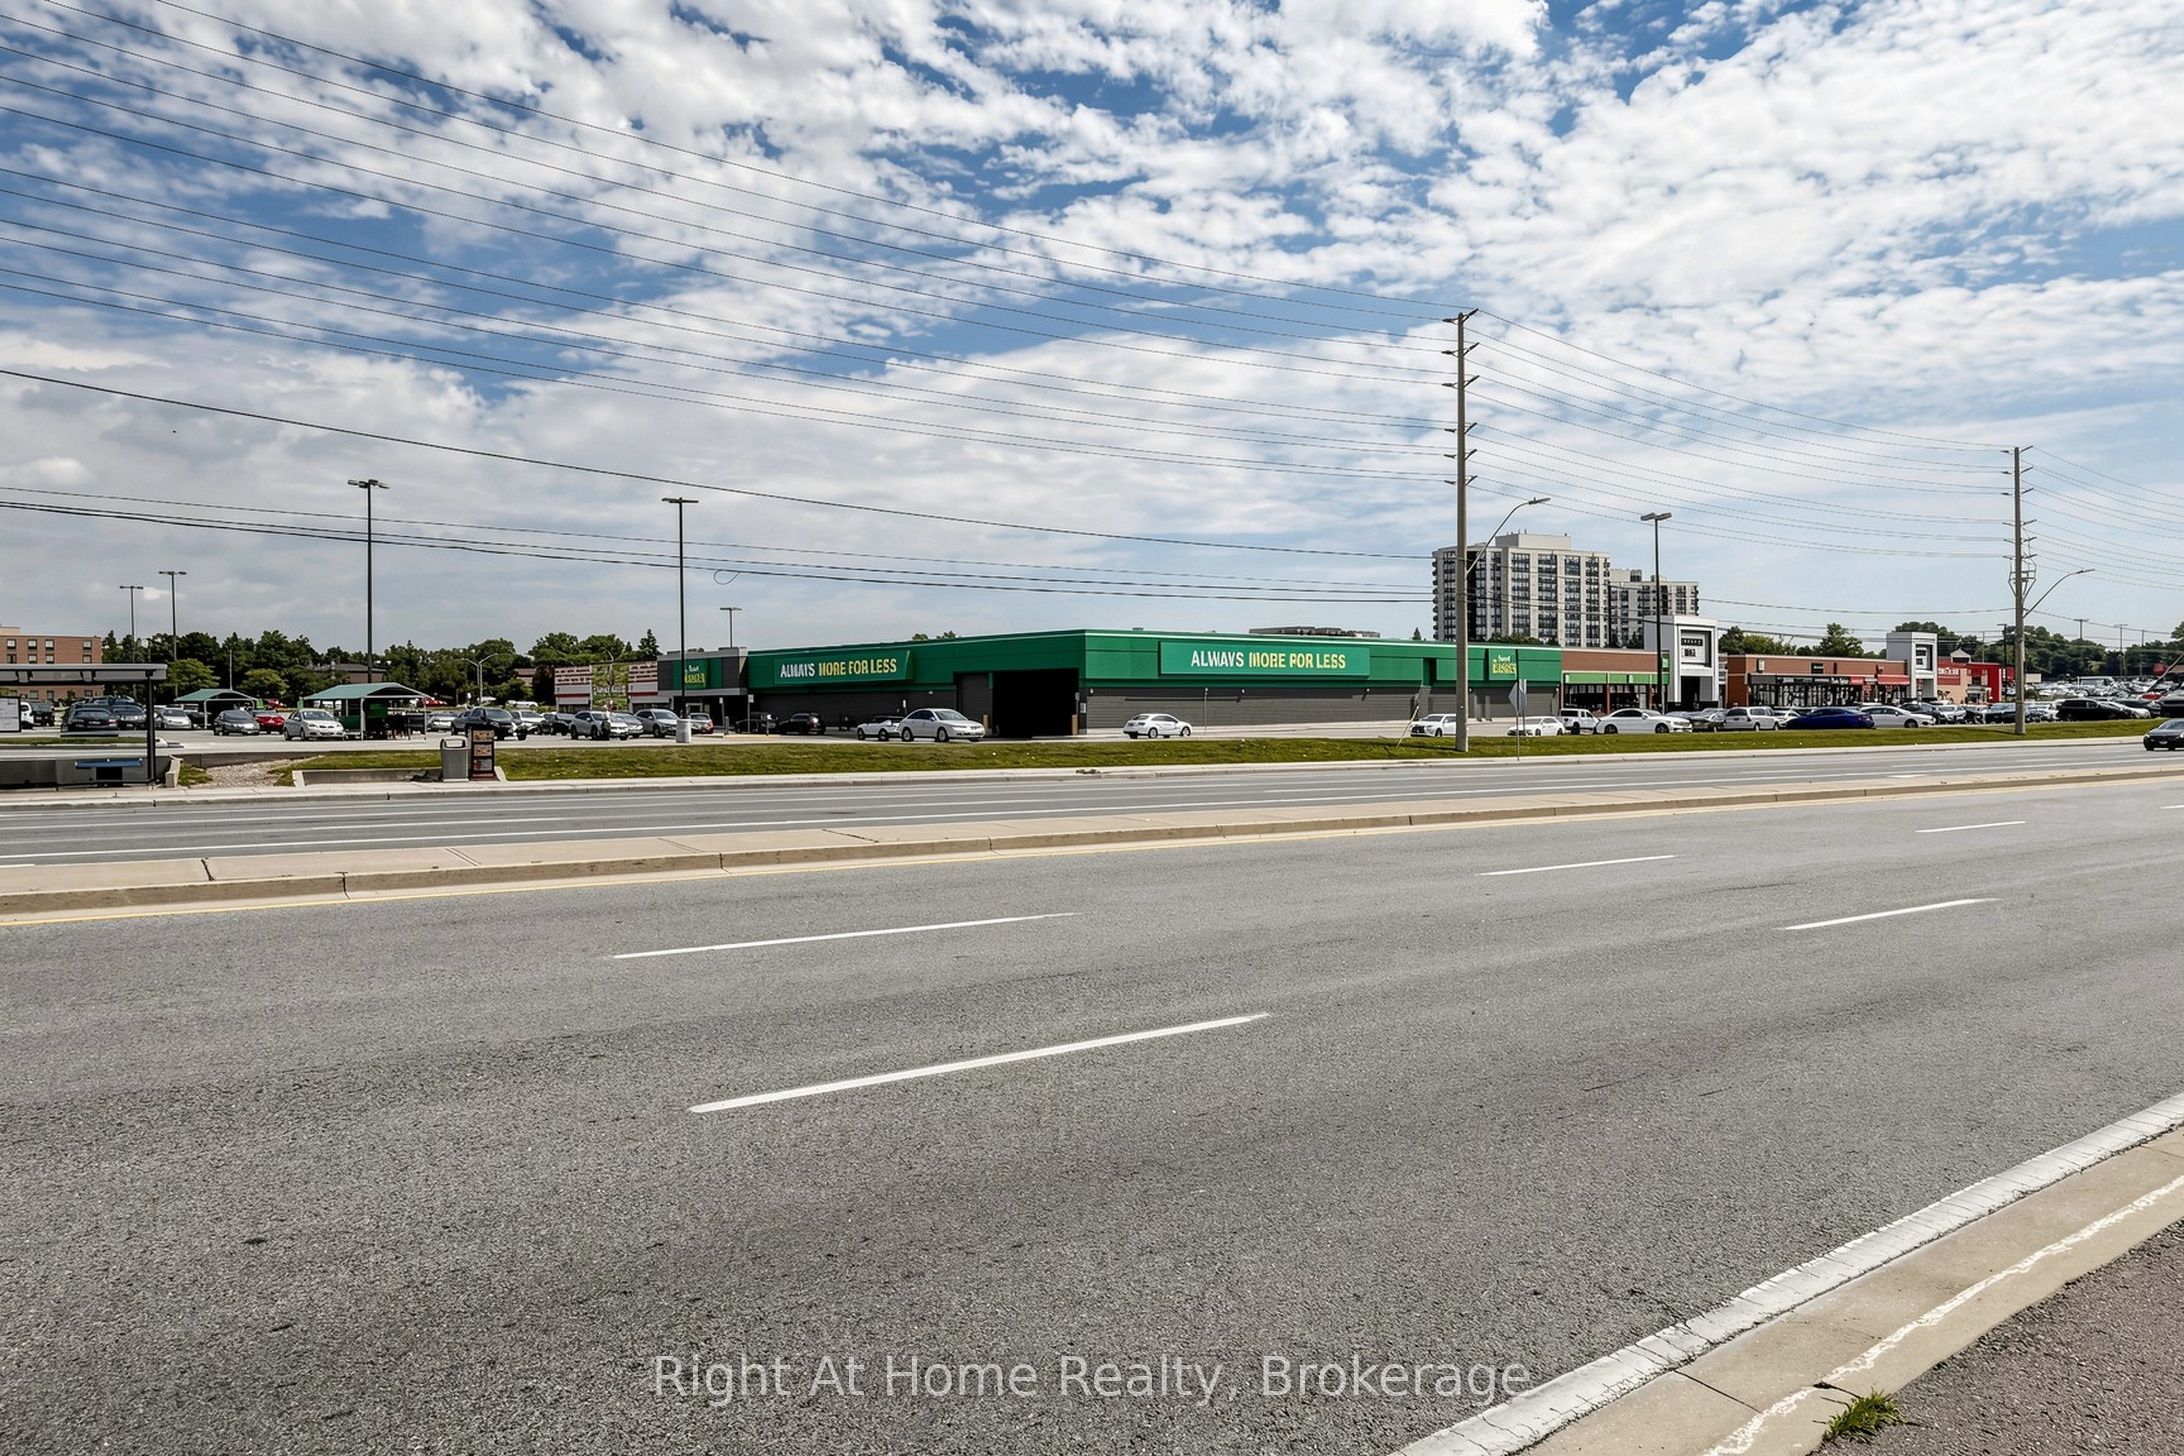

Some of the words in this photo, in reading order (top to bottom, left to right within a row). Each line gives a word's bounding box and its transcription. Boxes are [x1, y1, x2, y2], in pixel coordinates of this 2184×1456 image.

[848, 660, 869, 675] FOR
[870, 658, 898, 674] LESS
[1190, 650, 1245, 667] ALWAYS
[1248, 652, 1286, 668] MORE
[1289, 652, 1314, 668] FOR
[1316, 653, 1346, 669] LESS
